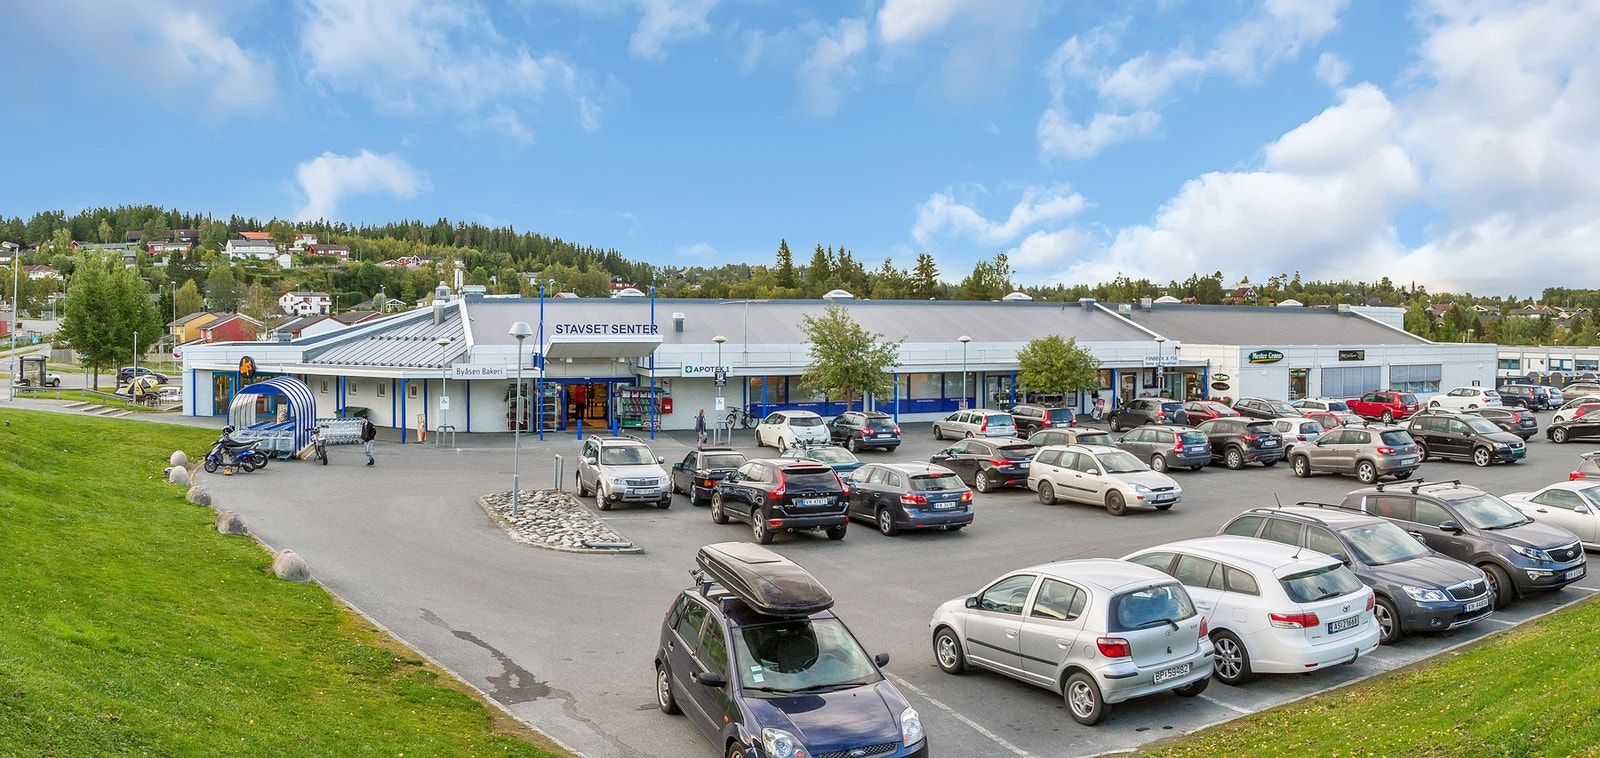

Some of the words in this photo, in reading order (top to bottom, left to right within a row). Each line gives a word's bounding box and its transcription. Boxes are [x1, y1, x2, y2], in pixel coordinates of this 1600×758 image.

[555, 324, 609, 334] STAVSET
[611, 324, 659, 334] SENTER
[456, 367, 480, 376] Byåsen
[482, 367, 503, 375] Bakeri
[1334, 622, 1341, 630] AS
[1155, 671, 1164, 680] BP
